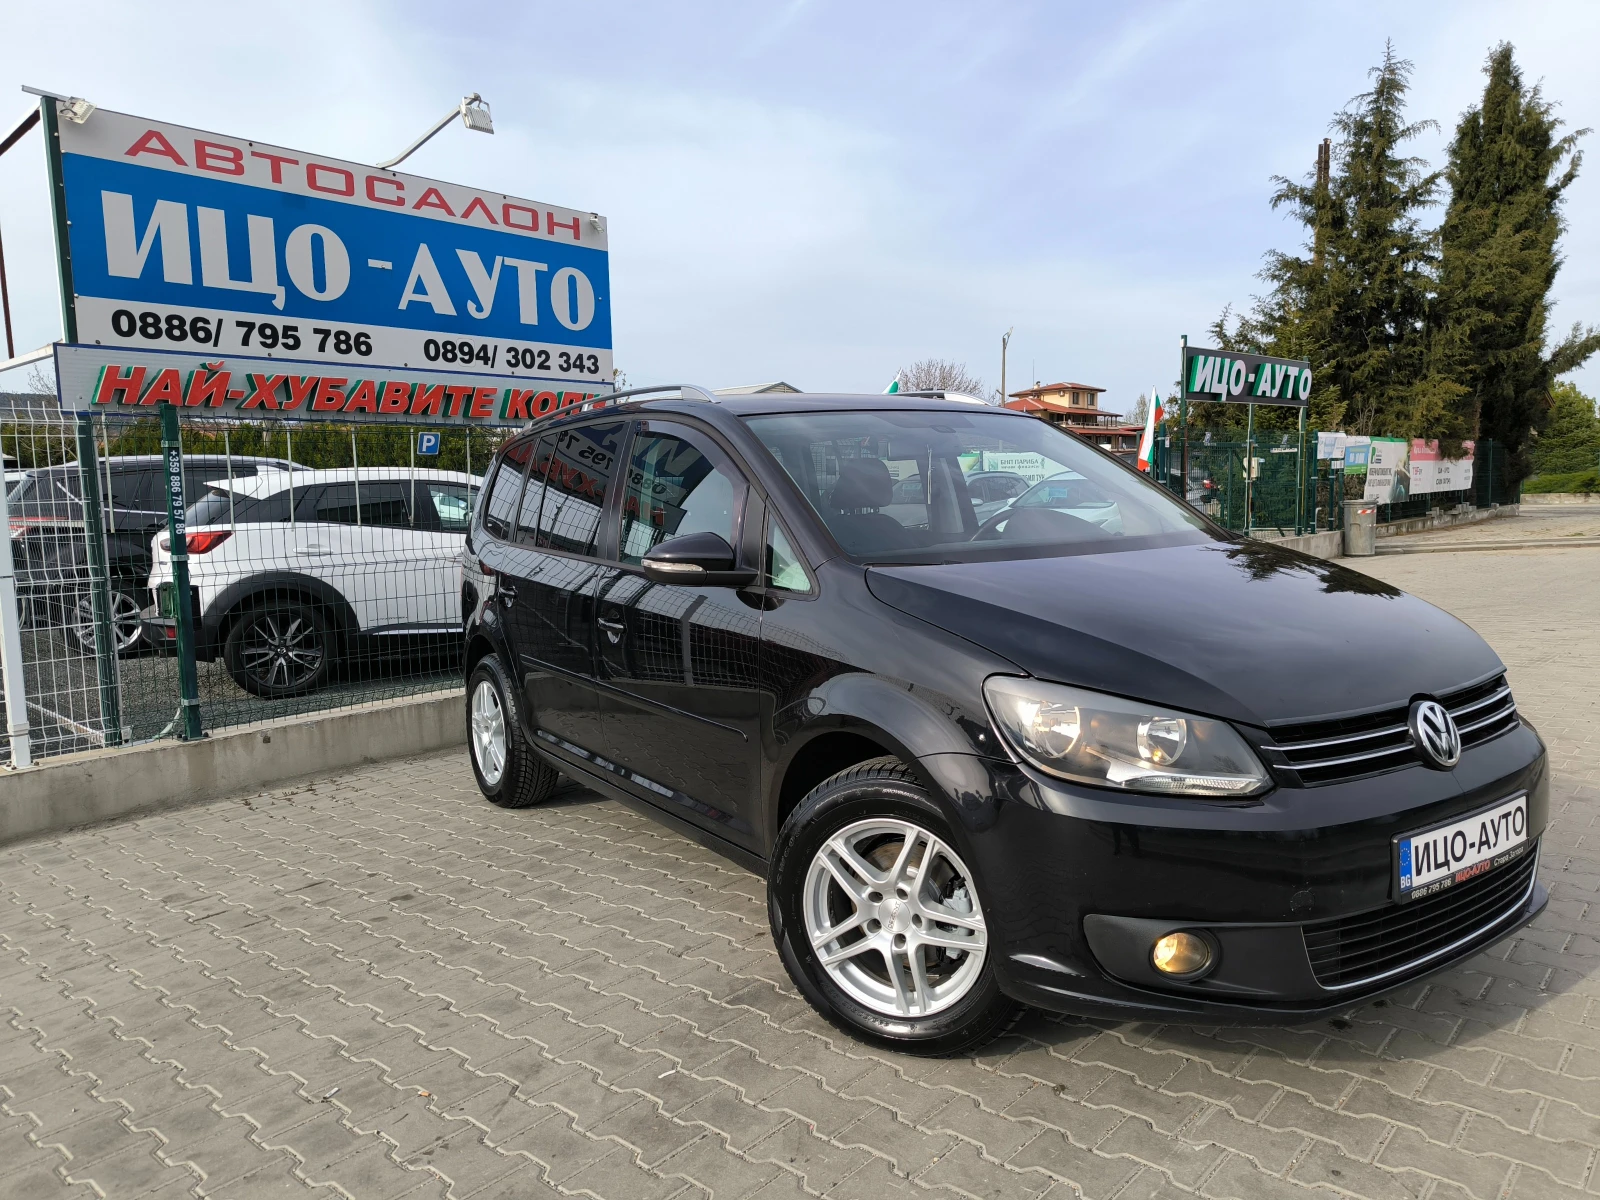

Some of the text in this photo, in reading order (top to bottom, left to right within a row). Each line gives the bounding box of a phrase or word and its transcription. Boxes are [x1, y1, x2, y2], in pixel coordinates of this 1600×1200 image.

[124, 129, 581, 241] АВТОСАЛОН
[111, 309, 373, 357] 0886/ 795 786
[423, 338, 600, 375] 0894/ 302 343
[1193, 355, 1312, 401] ИЦО-АУТО
[94, 360, 497, 418] НАЙ-ХУБАВИТЕ
[169, 450, 186, 535] +359 886 79 57 86
[1414, 806, 1525, 877] ИЦО-АУТО
[1494, 854, 1509, 867] Стара
[1400, 875, 1412, 889] BG
[1411, 878, 1452, 900] 0886 795 786
[1455, 860, 1491, 883] ИЦО-АУТО
